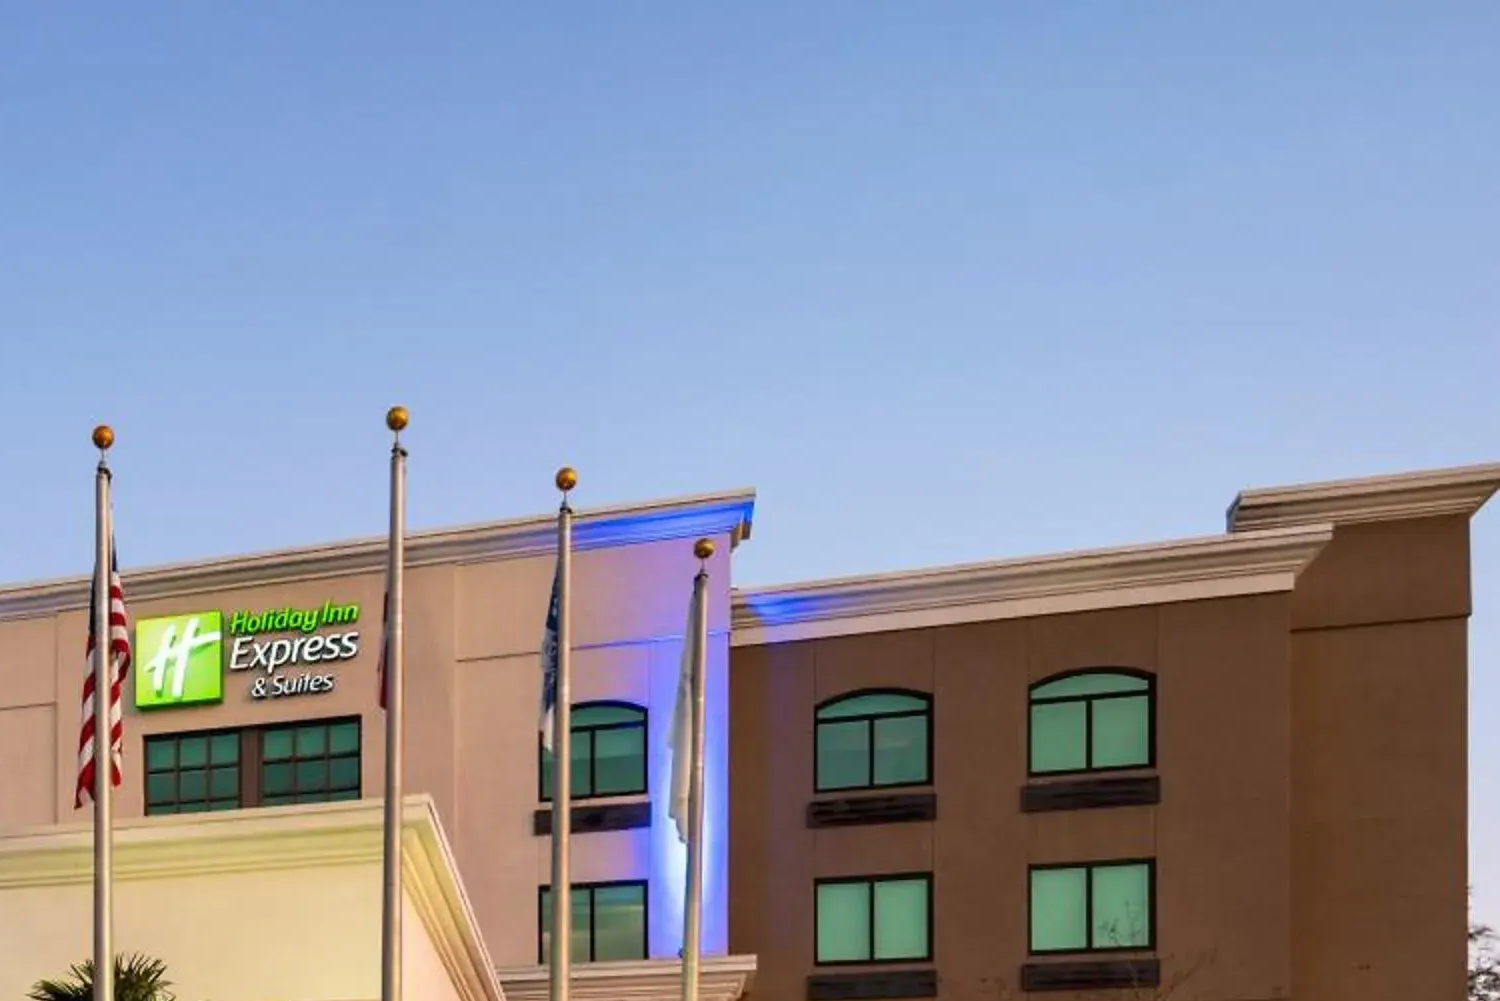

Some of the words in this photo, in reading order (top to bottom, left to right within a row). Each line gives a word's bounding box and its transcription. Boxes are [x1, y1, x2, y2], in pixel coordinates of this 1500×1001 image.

[230, 607, 318, 633] Holiday
[322, 600, 358, 623] Inn
[230, 632, 359, 674] Express
[252, 677, 266, 697] &
[272, 673, 333, 695] Suites
